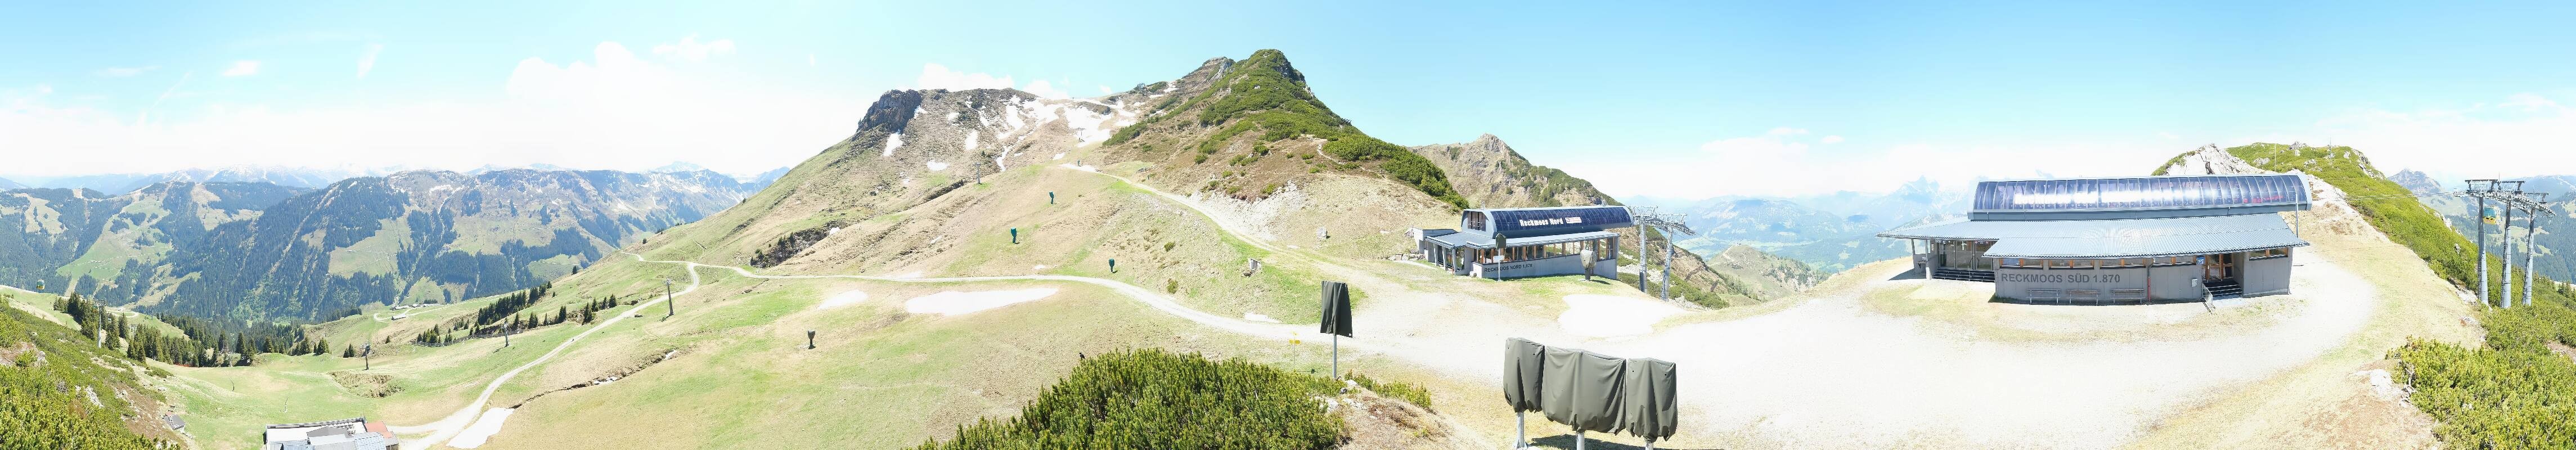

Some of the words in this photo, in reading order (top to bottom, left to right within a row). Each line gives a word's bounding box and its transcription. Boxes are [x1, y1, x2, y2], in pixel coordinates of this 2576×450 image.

[2001, 273, 2063, 283] RECKMOOS
[2067, 273, 2090, 283] SÜD
[2093, 274, 2120, 283] 1.870
